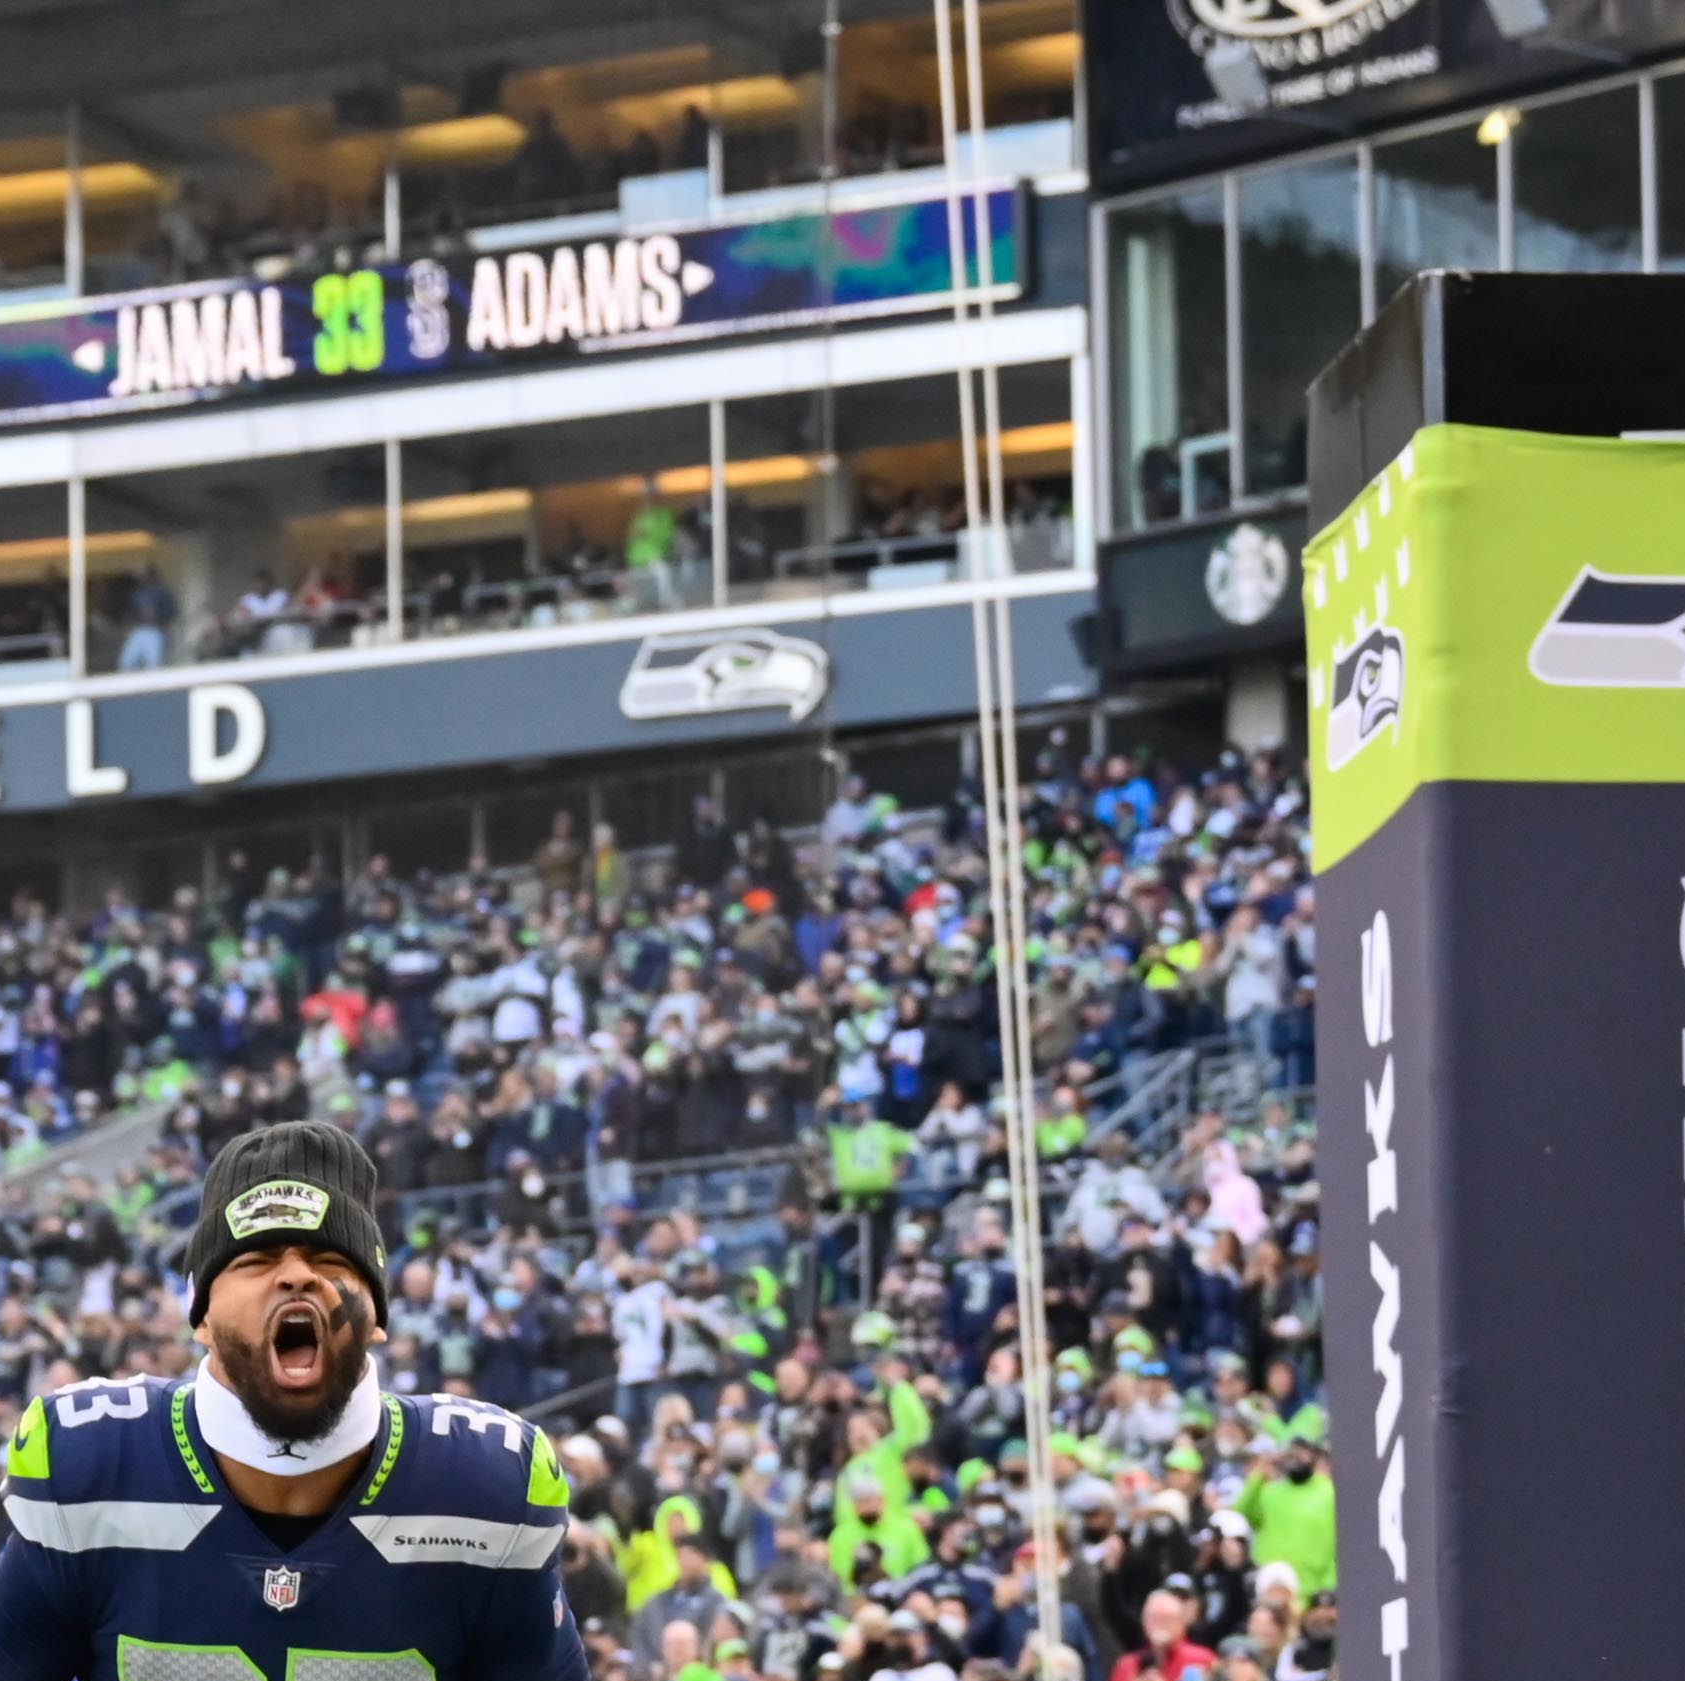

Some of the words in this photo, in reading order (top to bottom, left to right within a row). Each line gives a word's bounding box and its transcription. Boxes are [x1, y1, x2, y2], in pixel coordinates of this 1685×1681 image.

[108, 287, 295, 397] JAMAL
[313, 269, 385, 376] 33
[467, 234, 682, 352] ADAMS
[393, 1533, 489, 1552] SEAHAWKS
